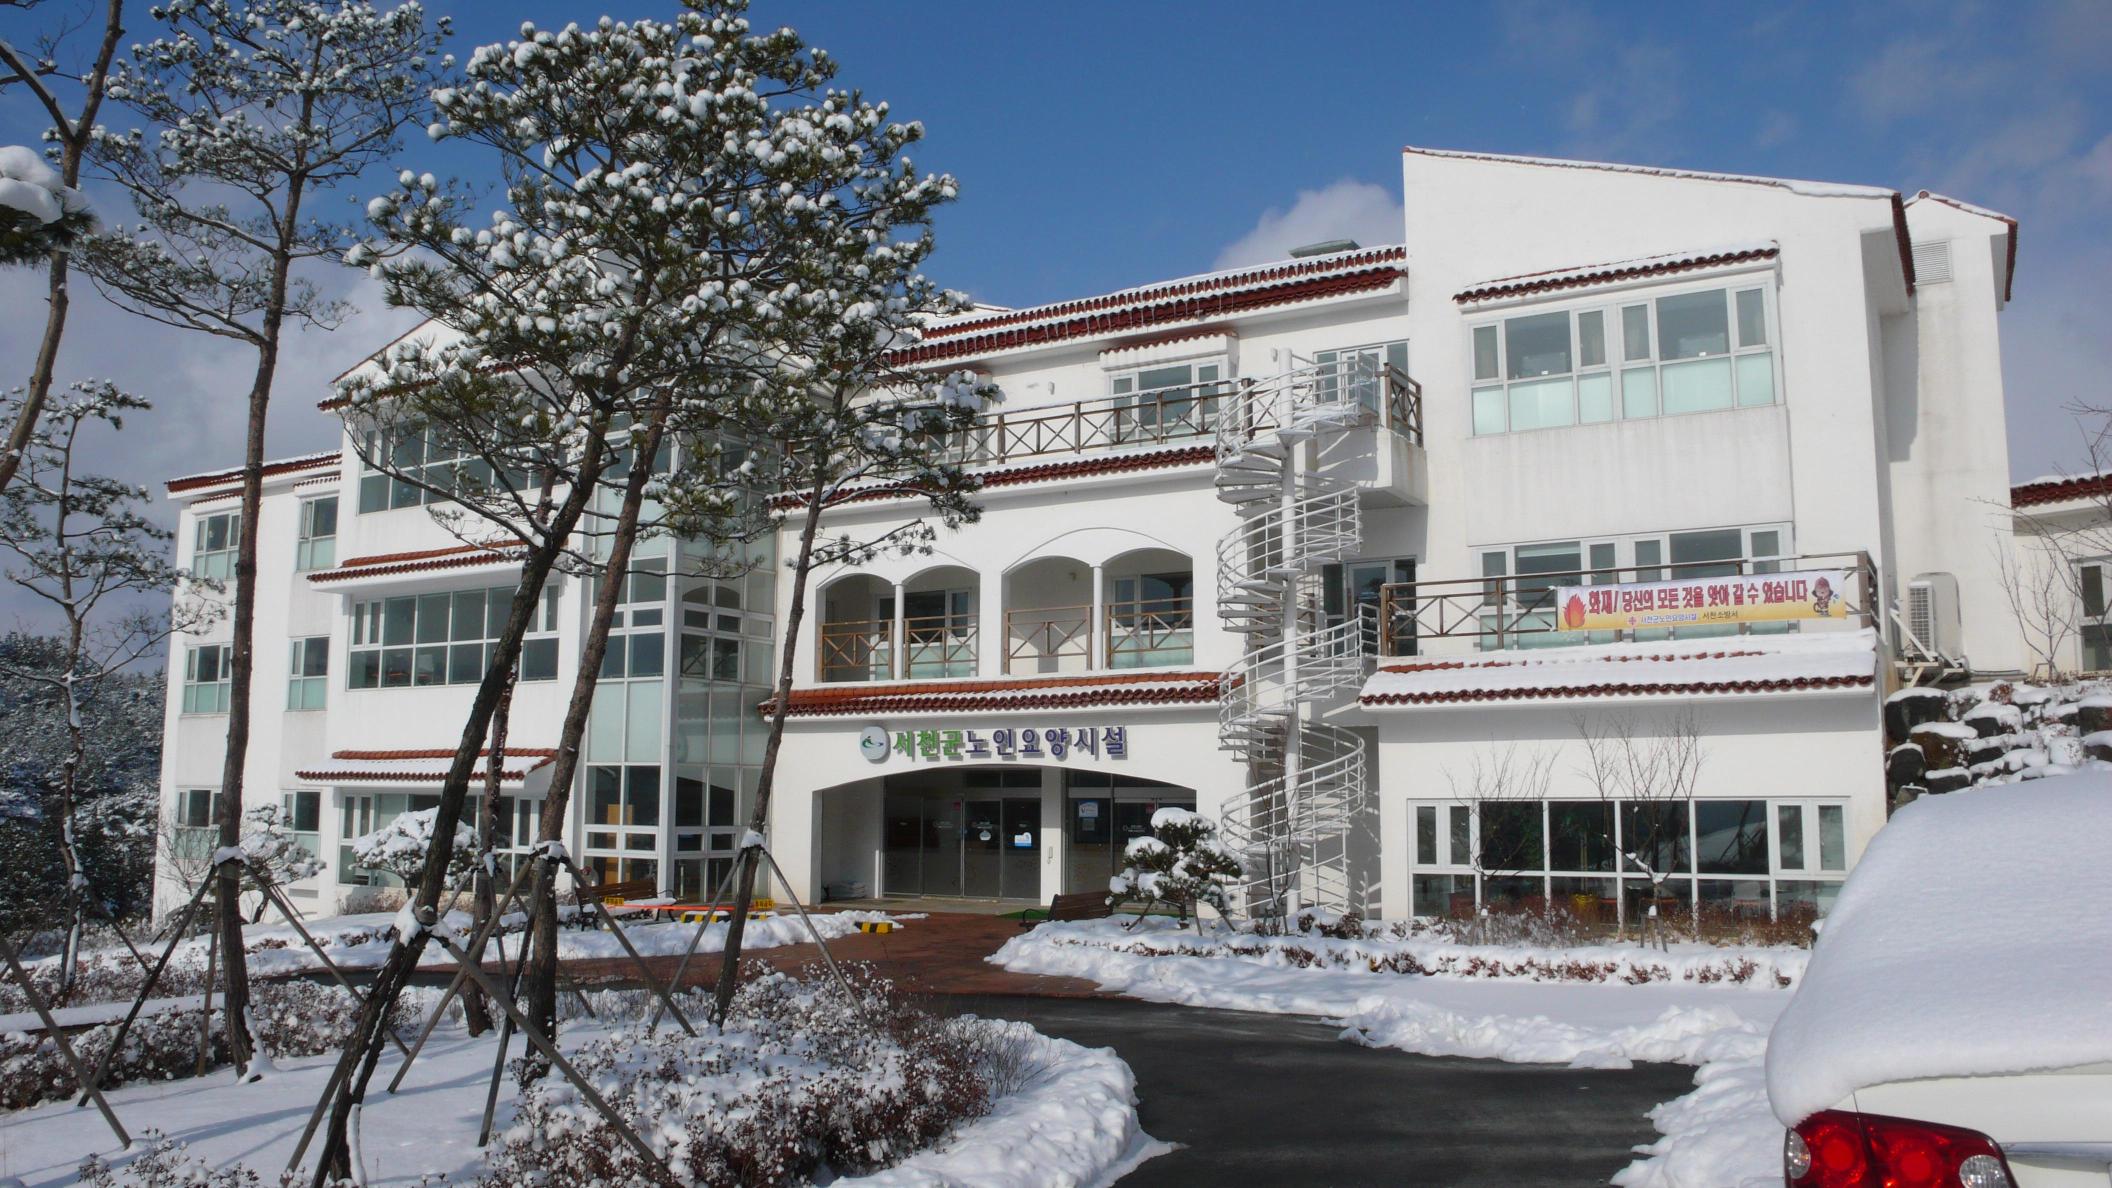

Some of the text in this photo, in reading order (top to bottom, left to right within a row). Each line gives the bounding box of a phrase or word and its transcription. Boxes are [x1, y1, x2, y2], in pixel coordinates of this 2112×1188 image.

[1622, 590, 1653, 612] 당신의
[1658, 588, 1679, 609] 모든
[1682, 586, 1704, 608] 것을
[1733, 583, 1744, 605] 갈
[1747, 583, 1758, 604] 수
[1762, 580, 1807, 603] 있습니다
